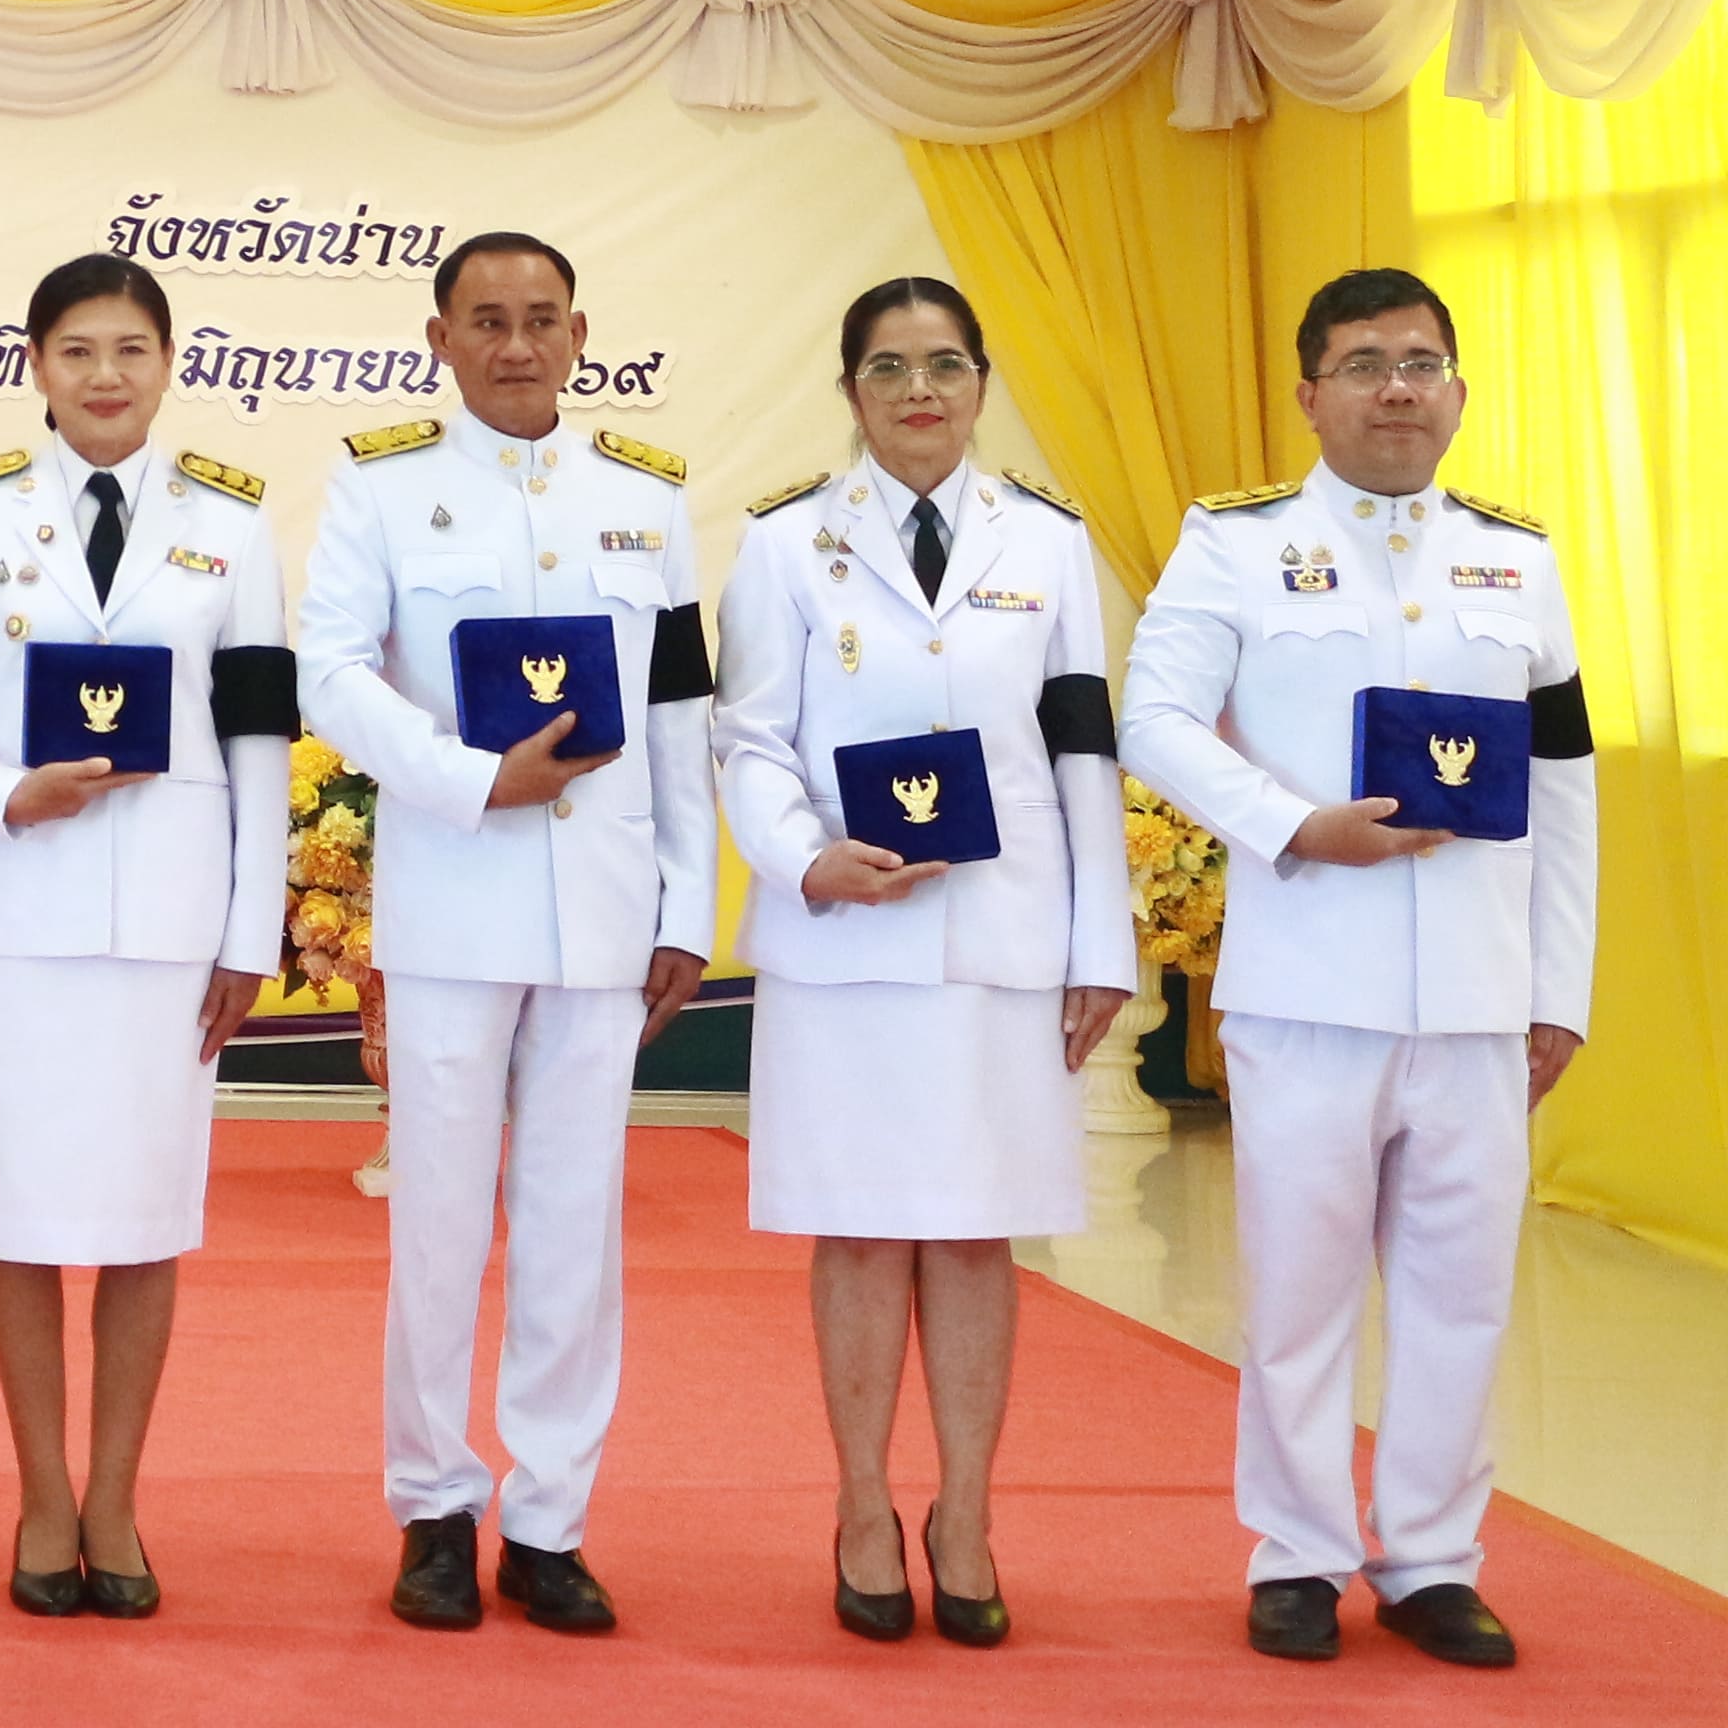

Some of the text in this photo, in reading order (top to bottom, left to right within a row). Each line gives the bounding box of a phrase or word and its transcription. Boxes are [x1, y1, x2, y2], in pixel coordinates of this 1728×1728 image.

[107, 192, 446, 268] จังหวัดน่าน
[178, 326, 441, 413] มิถุนายน
